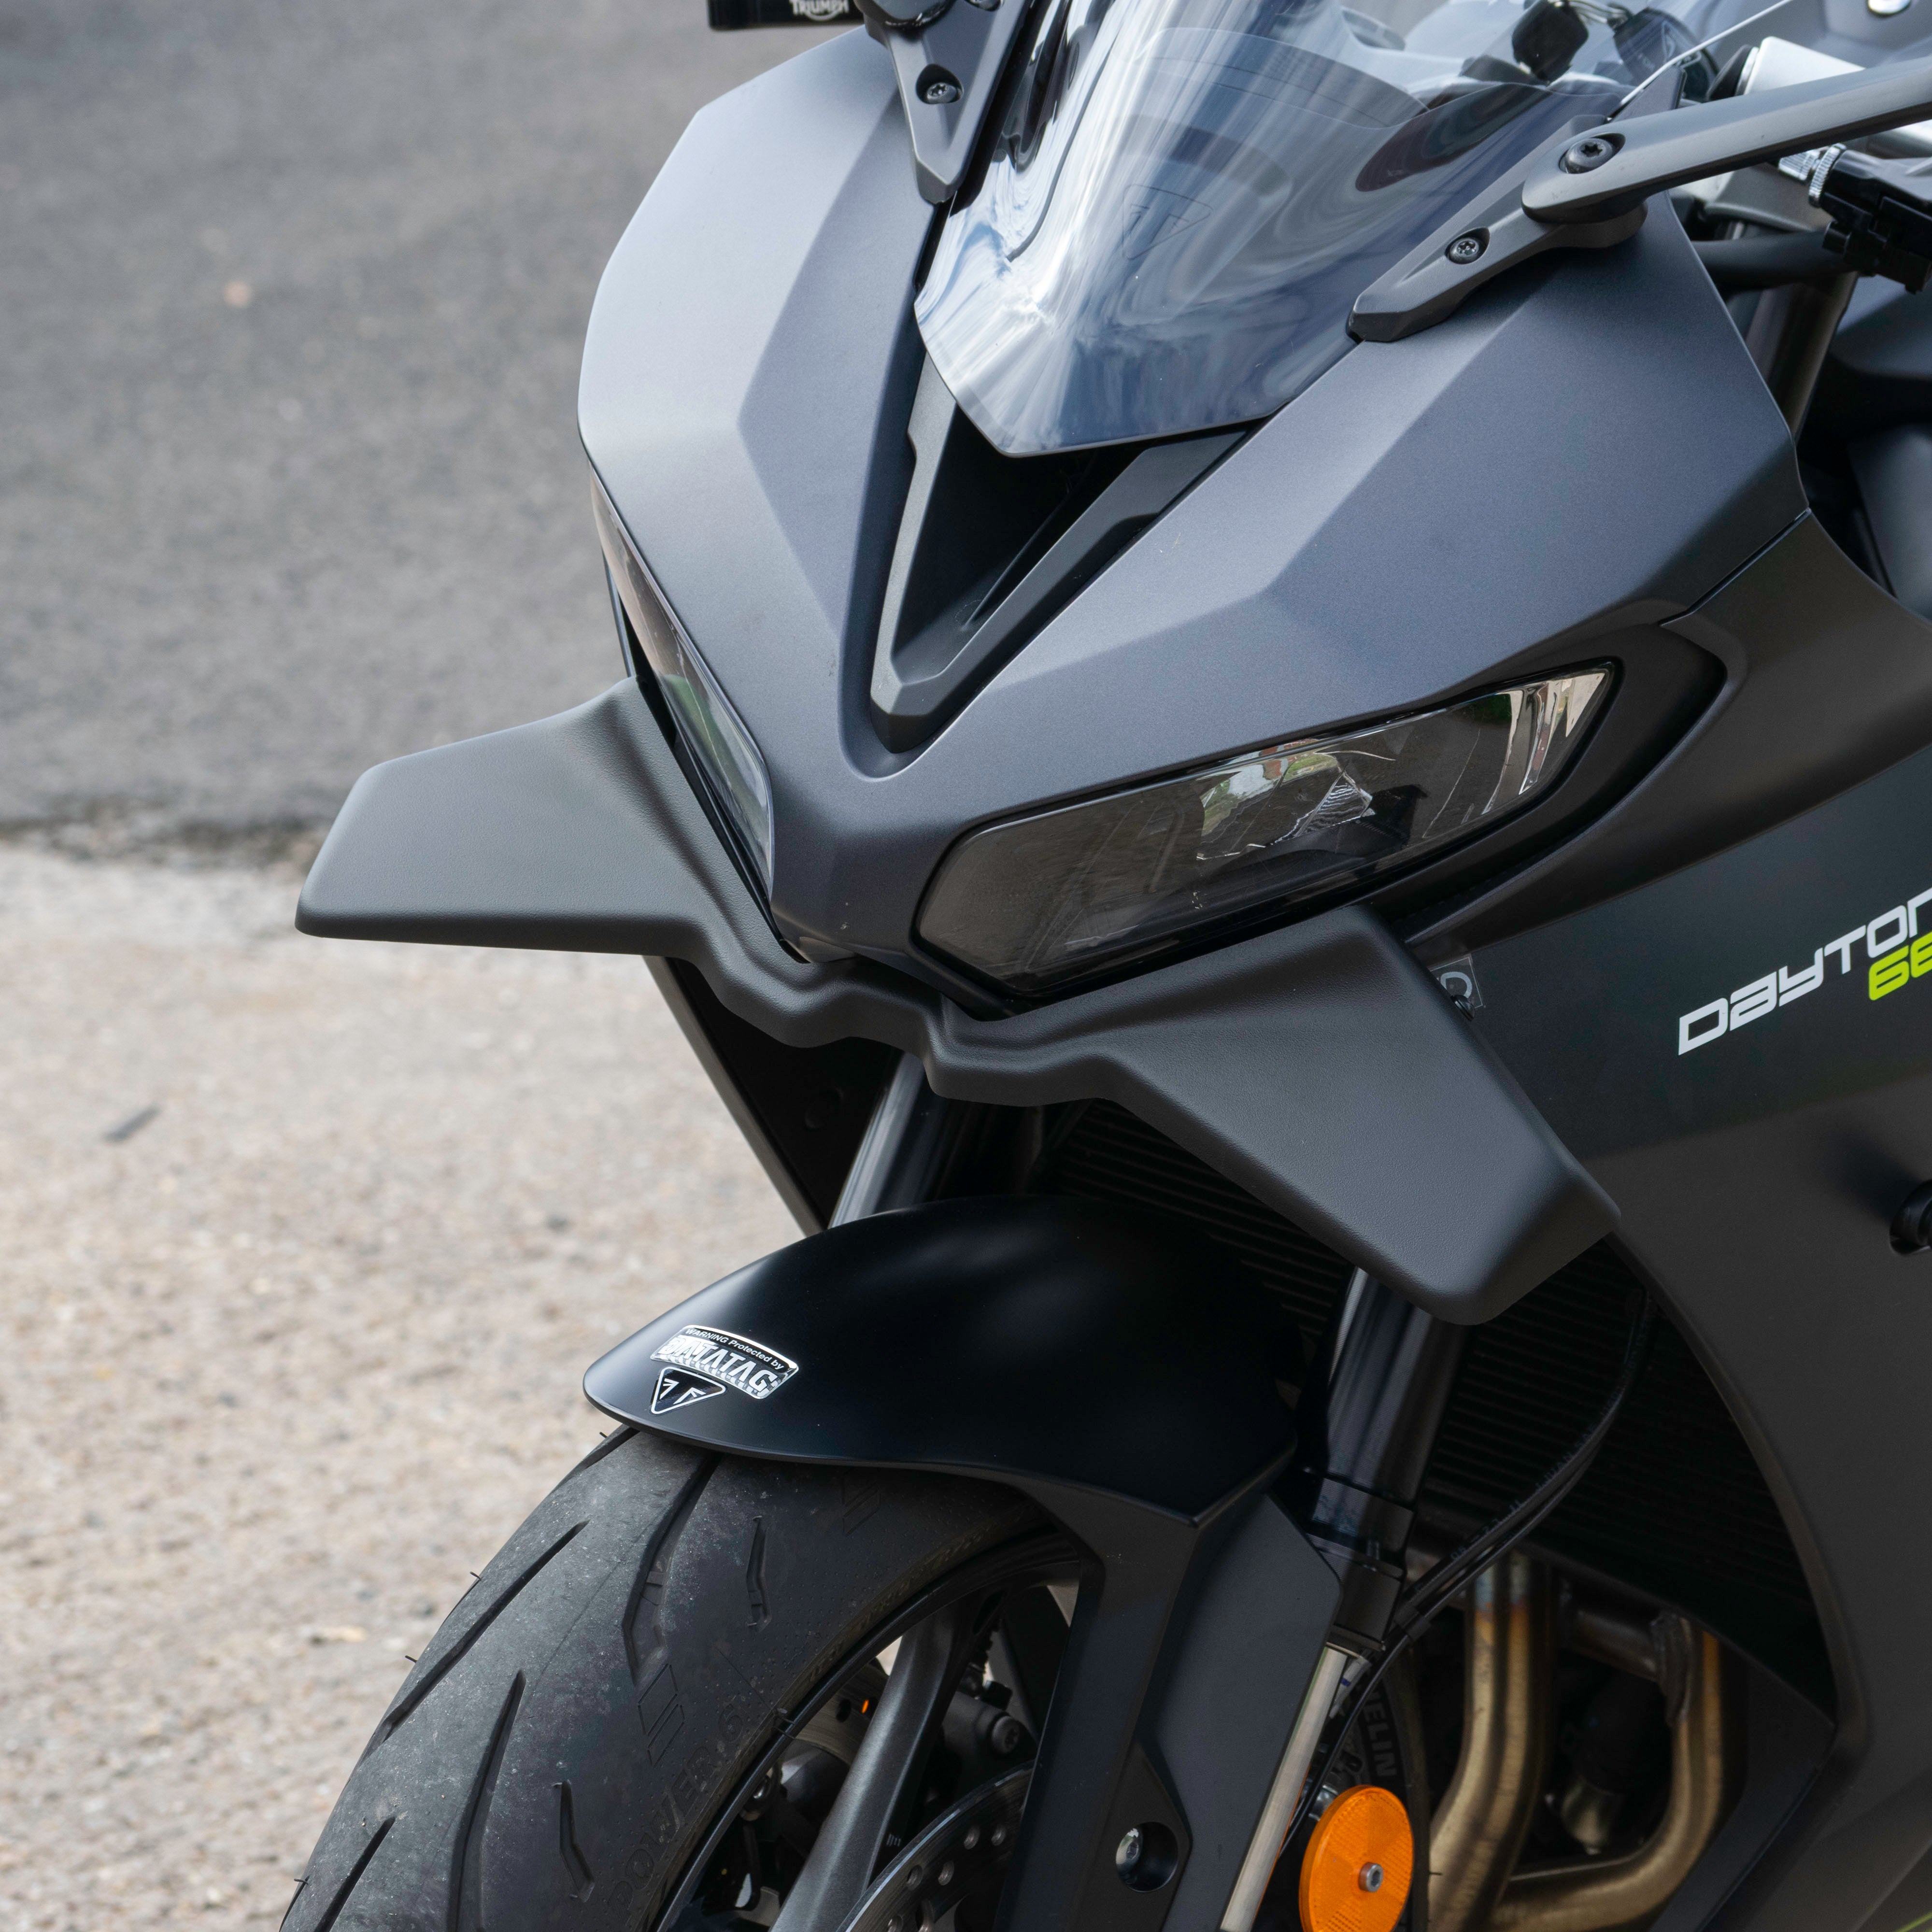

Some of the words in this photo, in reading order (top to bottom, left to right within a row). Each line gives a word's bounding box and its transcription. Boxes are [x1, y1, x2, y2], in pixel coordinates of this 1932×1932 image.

[789, 0, 850, 20] TRIUMPH
[658, 1335, 778, 1392] DATATAG
[685, 1329, 729, 1344] WARNING
[728, 1339, 772, 1362] Protected
[770, 1359, 784, 1370] by
